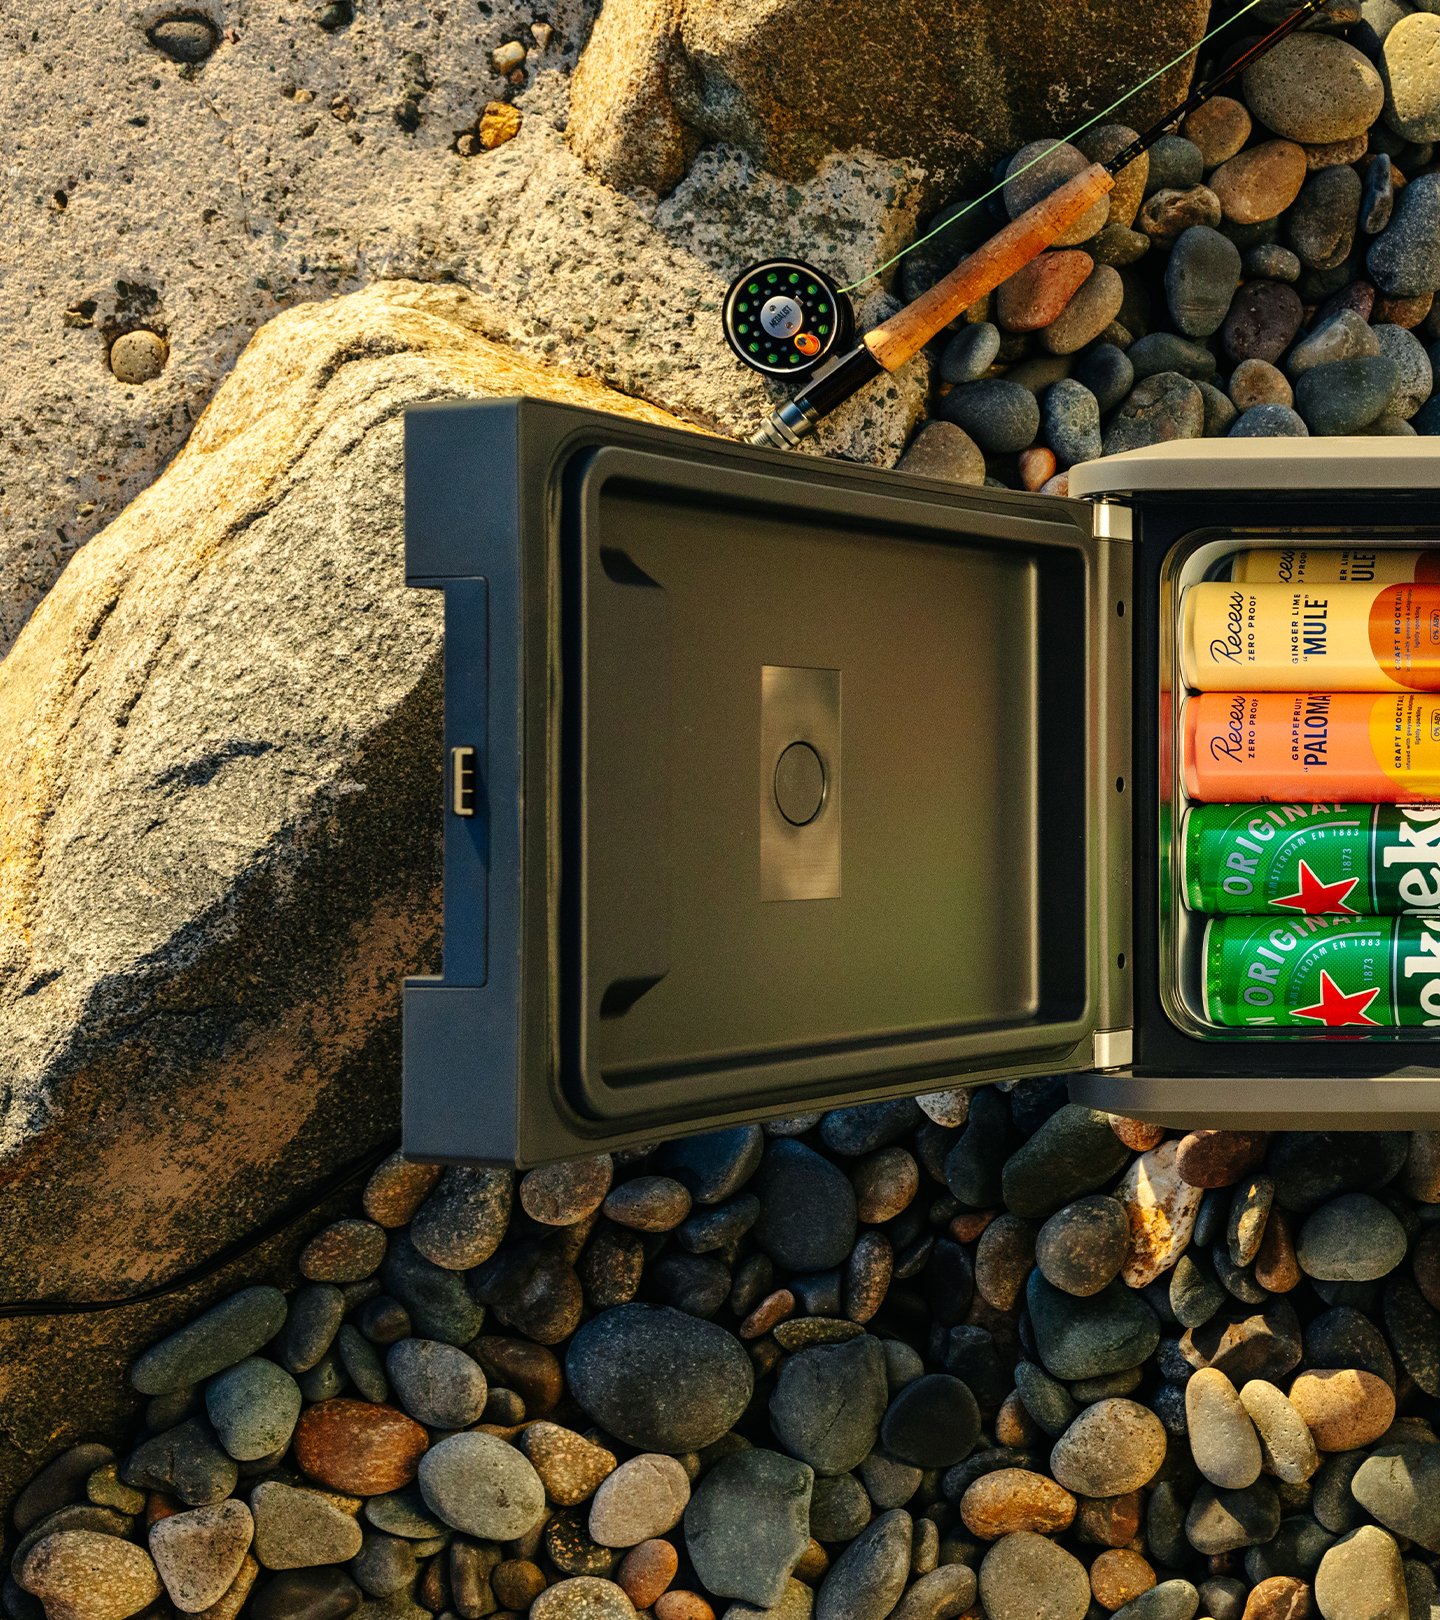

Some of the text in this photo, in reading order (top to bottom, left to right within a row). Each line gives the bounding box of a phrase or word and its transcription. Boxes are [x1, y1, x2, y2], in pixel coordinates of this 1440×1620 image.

[770, 304, 792, 329] MEDALIST
[1248, 596, 1256, 628] PROOF
[1292, 594, 1301, 616] LIME
[1394, 590, 1402, 634] MOCKTAIL
[1210, 591, 1243, 666] Recess
[1291, 621, 1299, 664] GINGER
[1433, 630, 1439, 640] 0%
[1210, 696, 1246, 763] Recess
[1249, 698, 1259, 725] PROOF
[1292, 698, 1303, 760] GRAPEFRUIT
[1434, 727, 1440, 737] 0%
[1222, 804, 1347, 896] ORIGINAL
[1268, 829, 1359, 895] AMSTERDAM EN 1883
[1342, 848, 1352, 872] 1873
[1289, 939, 1380, 1006] AMSTERDAM EN 1883
[1363, 958, 1373, 982] 1873
